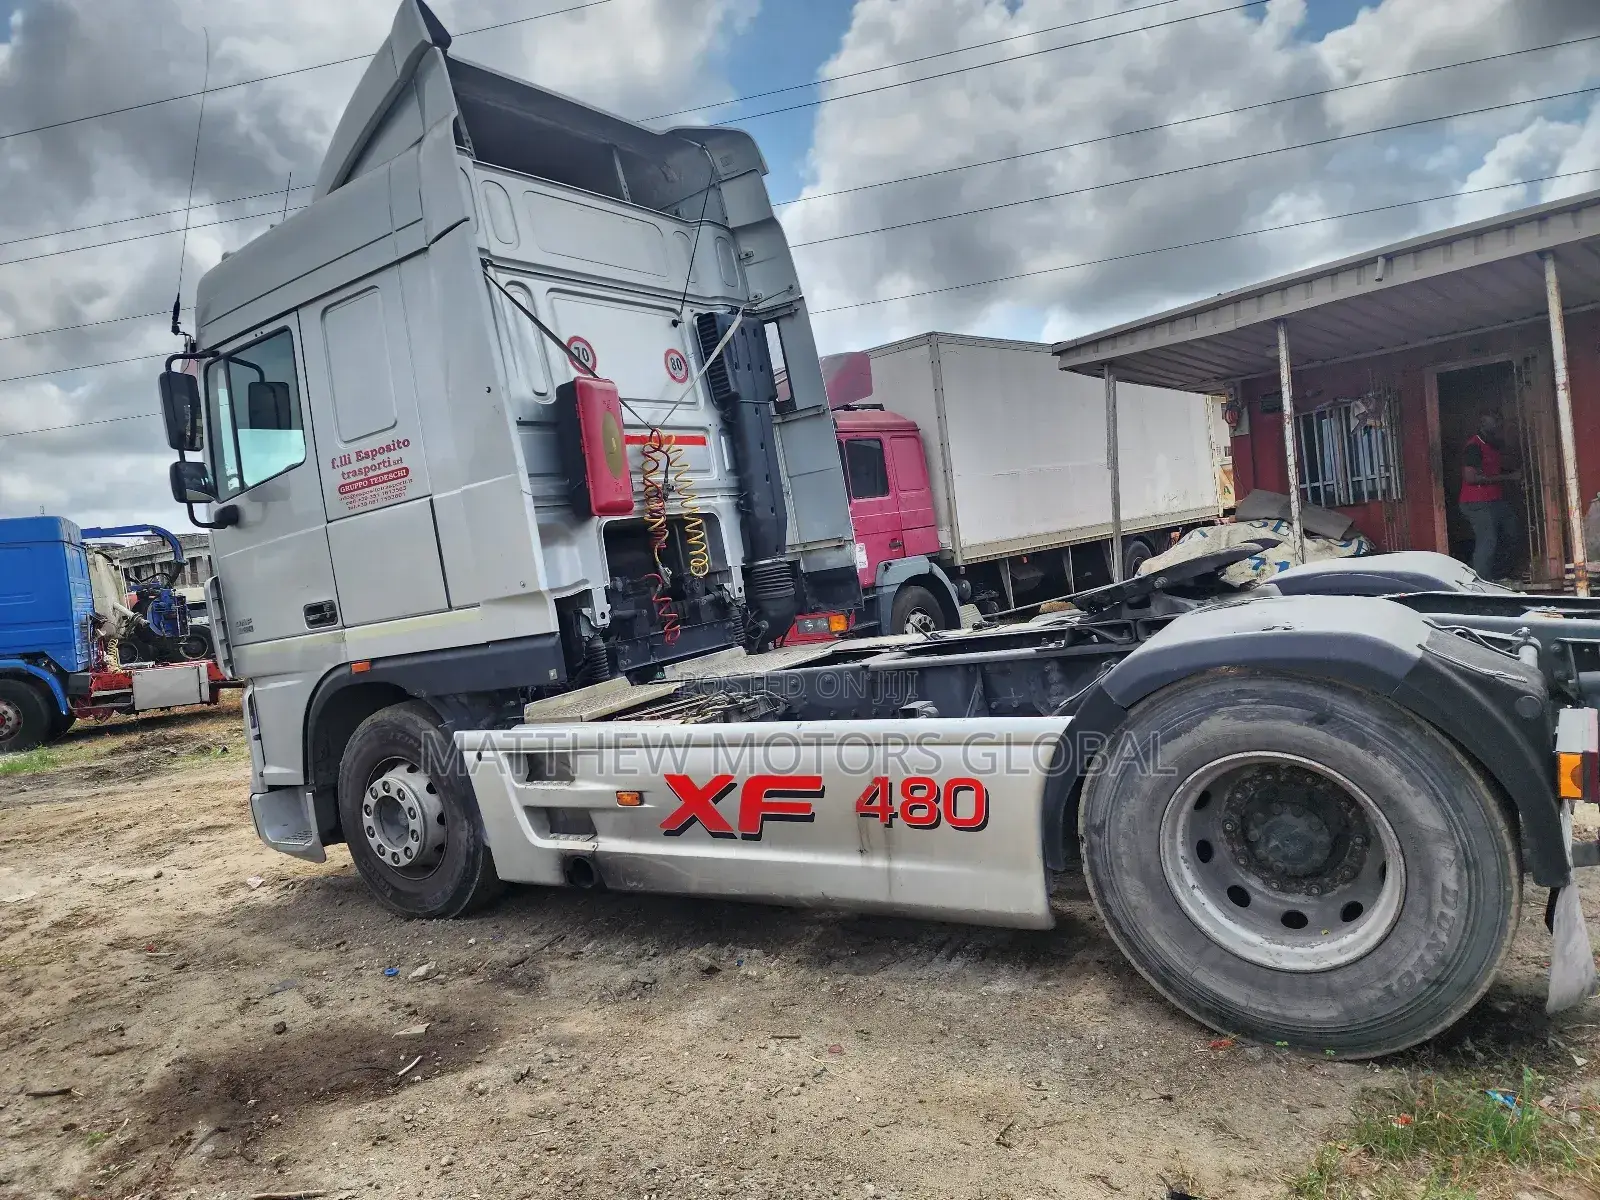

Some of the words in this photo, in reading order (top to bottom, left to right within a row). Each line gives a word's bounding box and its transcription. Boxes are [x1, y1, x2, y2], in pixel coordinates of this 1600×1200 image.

[573, 346, 590, 363] 70
[669, 357, 683, 372] 80
[331, 454, 352, 469] f.lli
[355, 438, 411, 462] Esposito
[341, 457, 392, 480] trasporti
[393, 457, 404, 466] srl
[340, 480, 368, 493] GRUPPO
[370, 469, 408, 485] TEDESCHI
[659, 773, 826, 842] XF
[855, 775, 990, 833] 480
